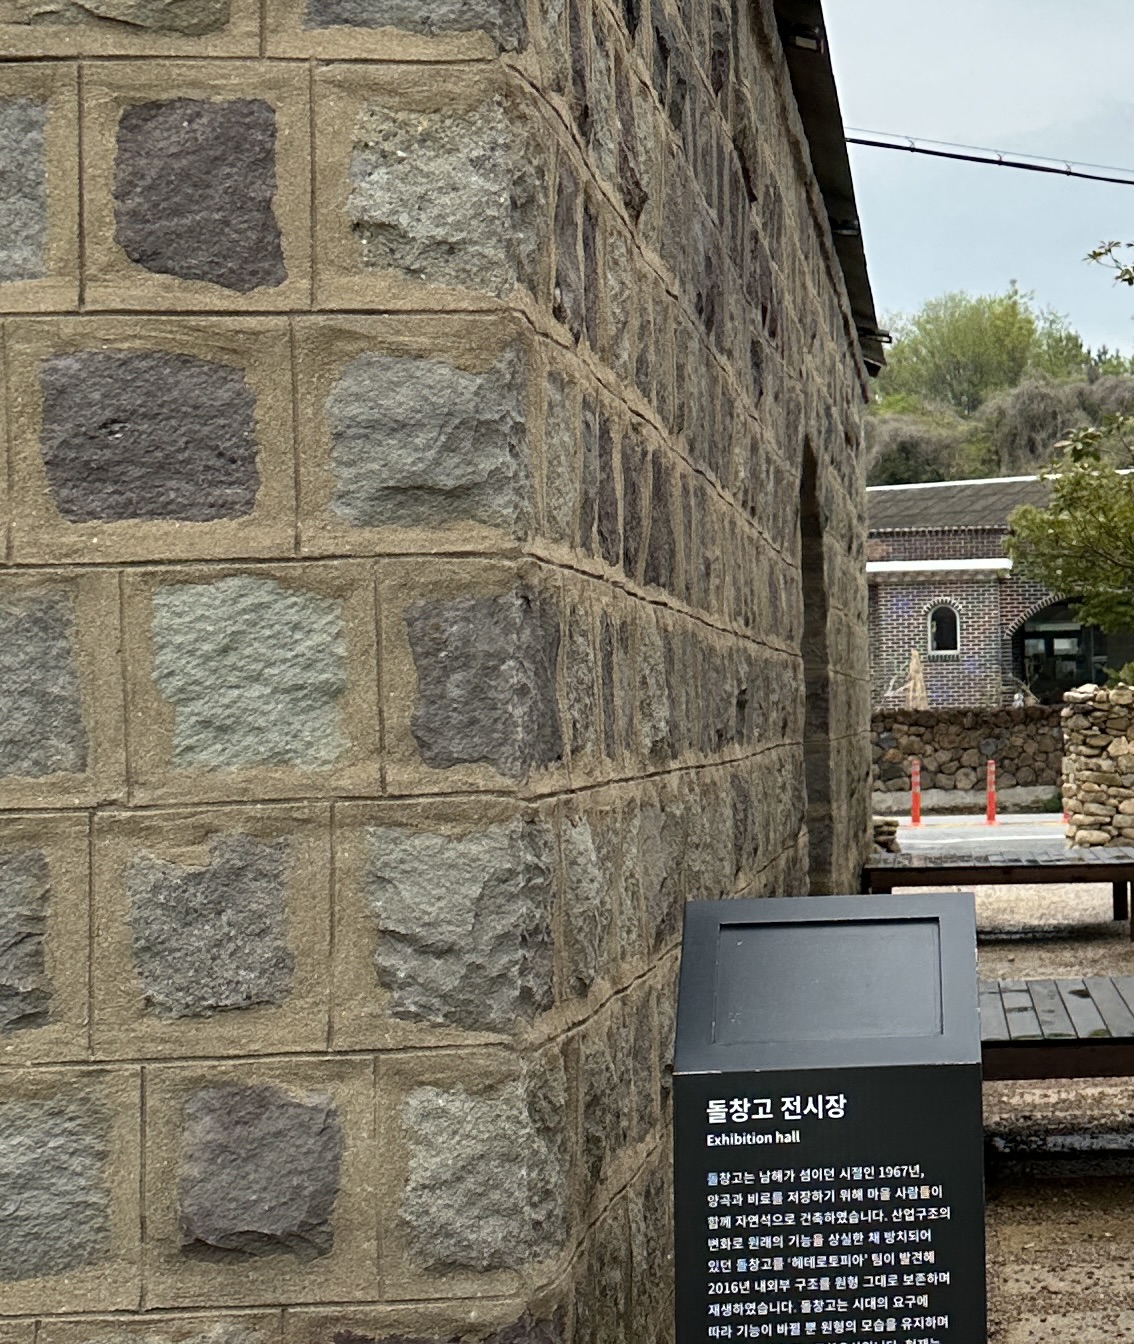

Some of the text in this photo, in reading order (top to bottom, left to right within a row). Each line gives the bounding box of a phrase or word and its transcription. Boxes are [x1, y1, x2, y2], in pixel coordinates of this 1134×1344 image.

[706, 1093, 848, 1125] 돌창고 전시장
[706, 1128, 801, 1147] Exhibition hall
[706, 1163, 925, 1187] 돌창고는 남해가 섬이던 시절인 1967년,
[707, 1184, 943, 1209] 양곡과 비료를 저장하기 위해 마을 사람들이
[707, 1205, 951, 1231] 함께 자연석으로 건축하였습니다. 산업구조의
[707, 1236, 744, 1252] 변화로
[747, 1233, 784, 1250] 원래의
[788, 1233, 825, 1249] 기능을
[827, 1230, 865, 1248] 상실한
[883, 1227, 932, 1245] 방치되어
[707, 1258, 732, 1274] 있던
[736, 1255, 785, 1273] 돌창고를
[871, 1251, 895, 1267] 팀이
[898, 1249, 935, 1266] 발견해
[707, 1270, 951, 1296] 2016년 내외부 구조를 원형 그대로 보존하며
[708, 1293, 929, 1318] 재생하였습니다. 돌창고는 시대의 요구에
[708, 1323, 733, 1340] 따라
[736, 1323, 773, 1339] 기능이
[820, 1318, 857, 1335] 원형의
[860, 1317, 898, 1333] 모습을
[900, 1314, 949, 1331] 유지하며
